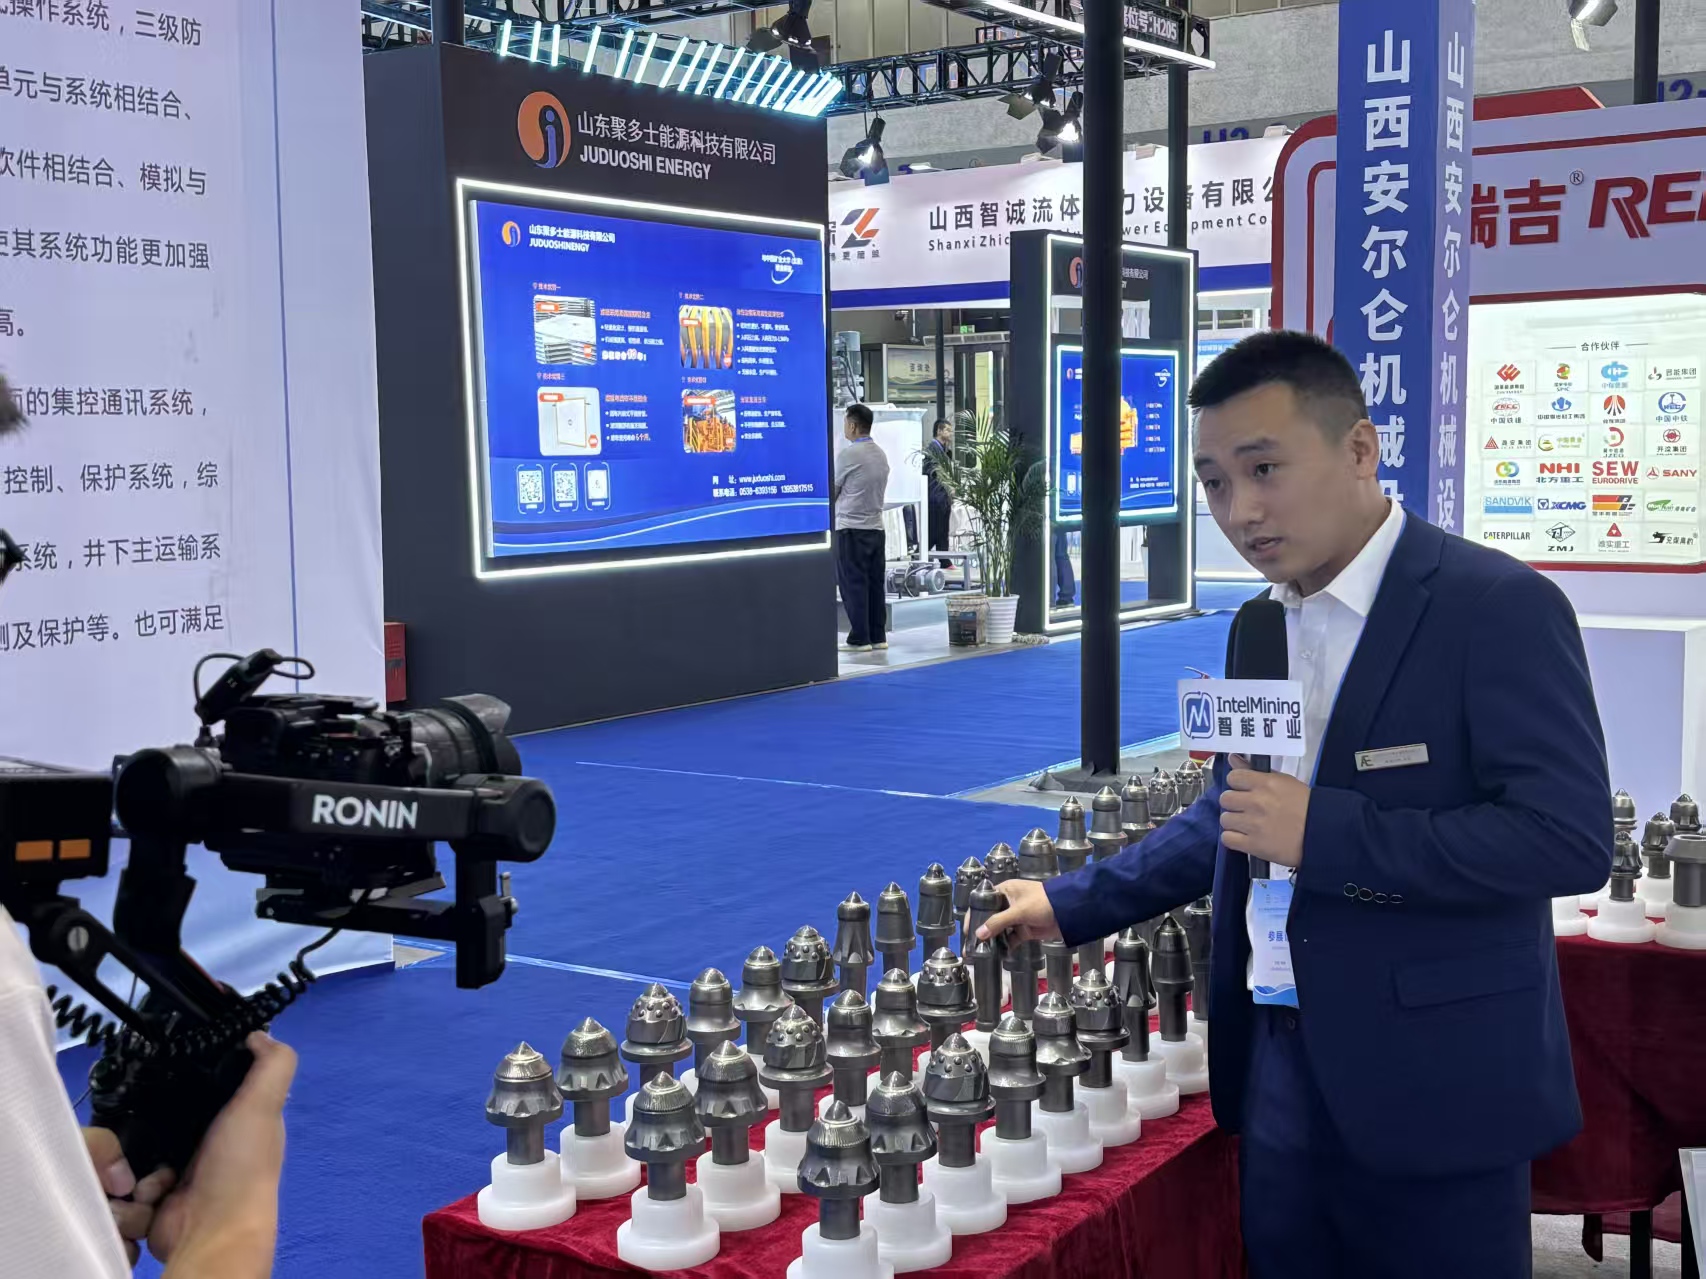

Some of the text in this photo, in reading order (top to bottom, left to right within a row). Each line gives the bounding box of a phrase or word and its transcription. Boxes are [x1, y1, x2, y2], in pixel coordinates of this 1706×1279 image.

[578, 111, 775, 165] 山东聚多士能源科技有限公司
[580, 145, 711, 180] JUDUOSHI ENERGY
[1588, 171, 1706, 239] RE
[1581, 341, 1620, 352] 合作伙伴
[1540, 463, 1580, 474] NHI
[1592, 461, 1639, 477] SEW
[1663, 470, 1697, 478] SANY
[1485, 496, 1532, 506] SANDVIK
[1550, 501, 1587, 510] XCMG
[1484, 532, 1531, 540] CATERPILLAR
[1216, 696, 1301, 719] IntelMining
[1217, 716, 1302, 740] 智能矿业
[312, 794, 418, 829] RONIN
